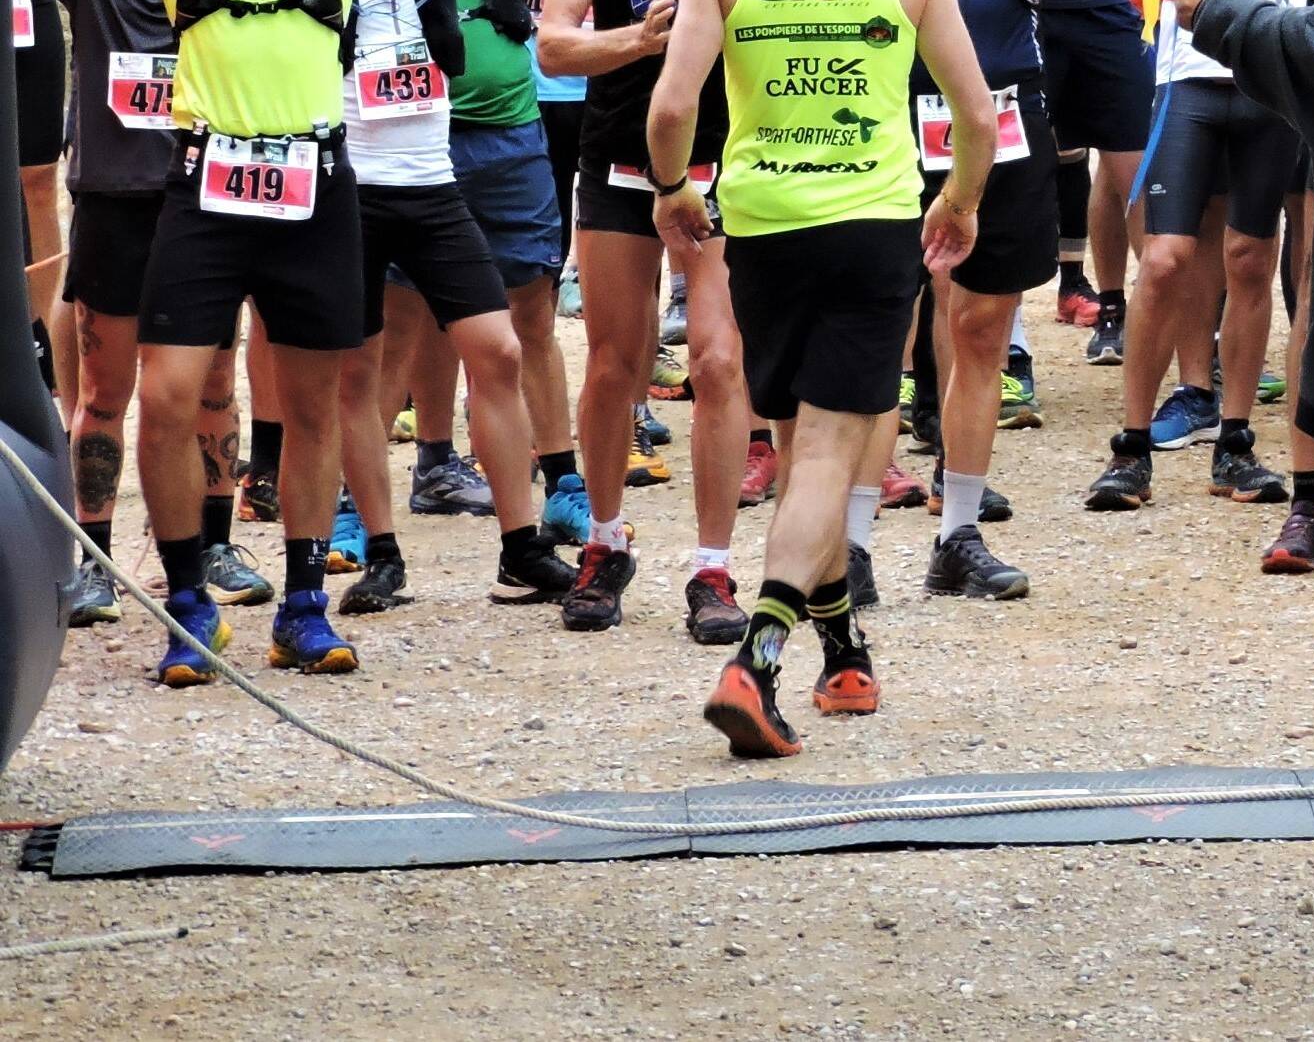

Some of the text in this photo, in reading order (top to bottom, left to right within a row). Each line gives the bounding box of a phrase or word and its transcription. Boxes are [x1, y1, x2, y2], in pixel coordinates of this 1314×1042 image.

[738, 24, 862, 39] LES POMPIERS DE L'ESPOIR
[376, 67, 431, 102] 433
[766, 77, 870, 96] CANCER
[225, 166, 284, 201] 419
